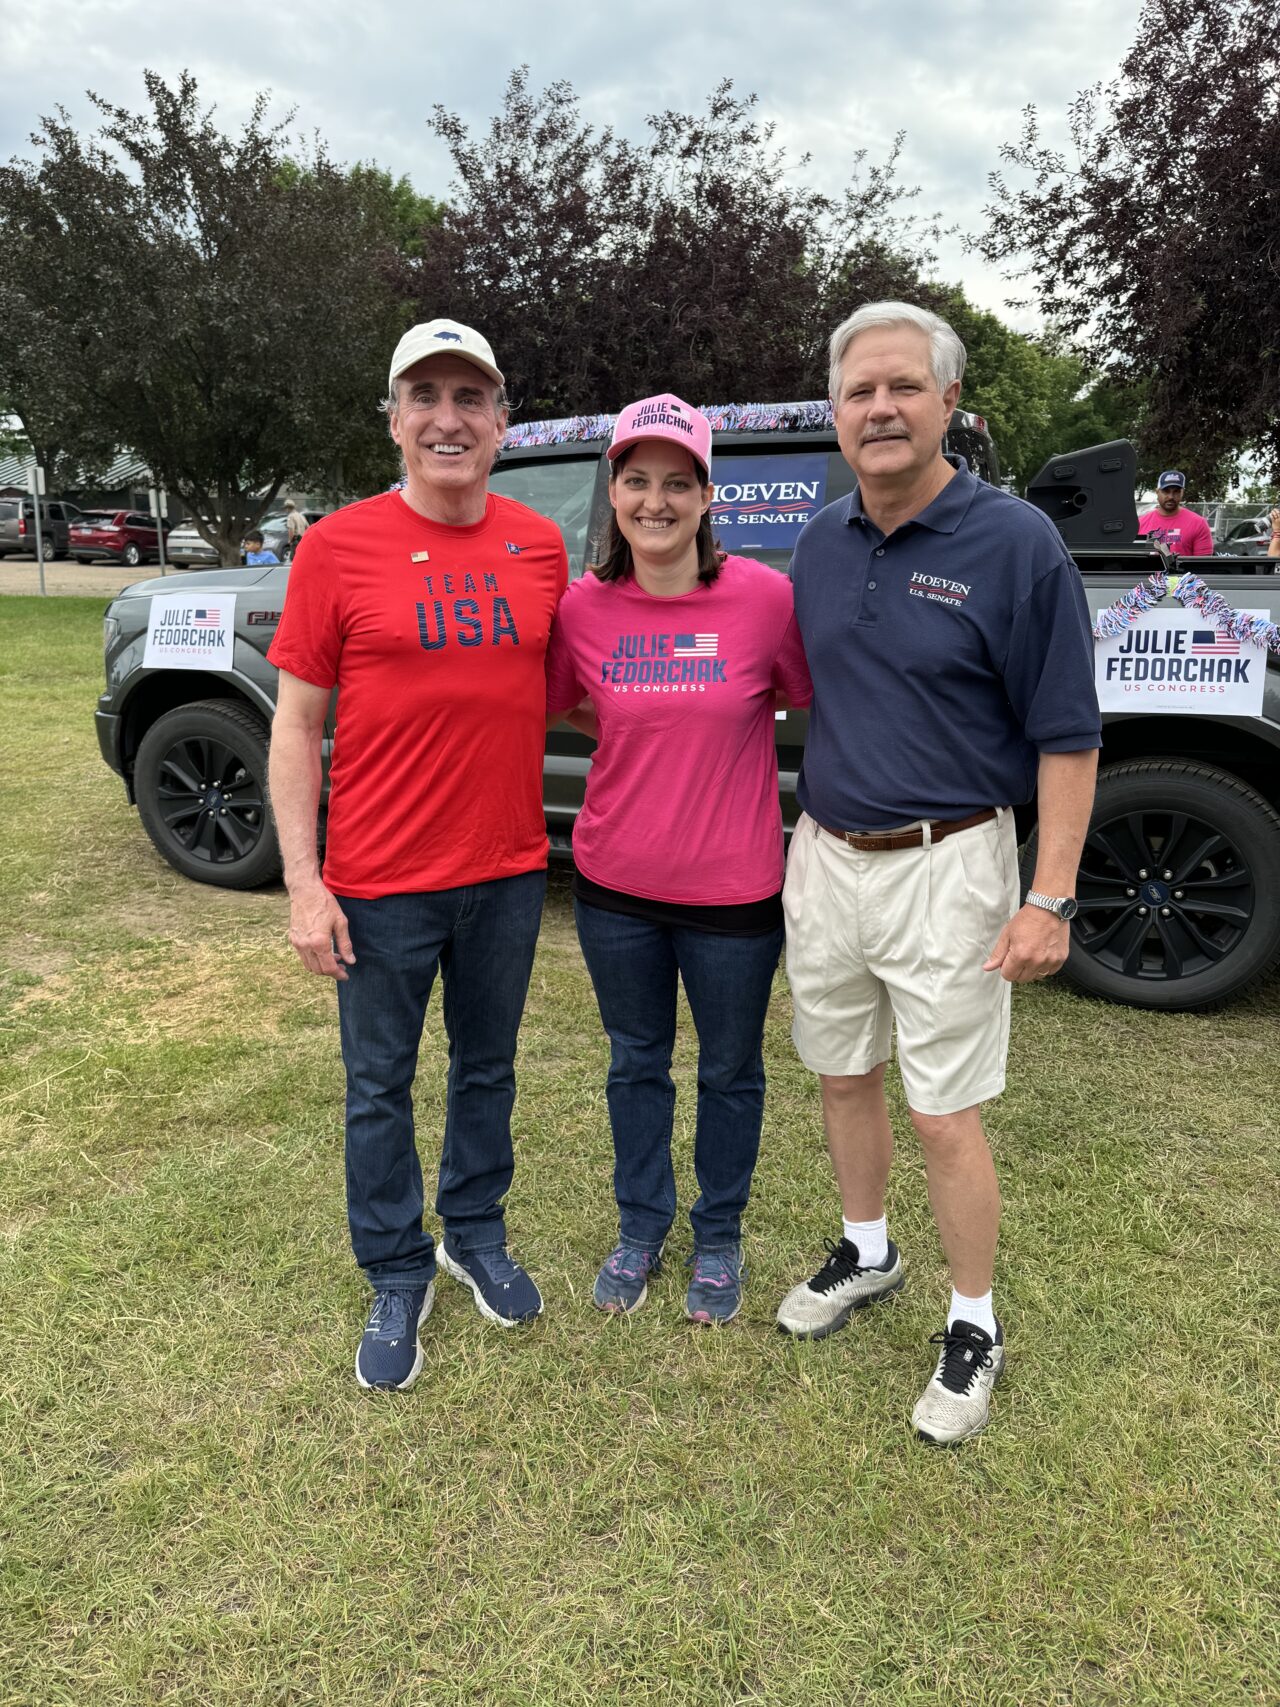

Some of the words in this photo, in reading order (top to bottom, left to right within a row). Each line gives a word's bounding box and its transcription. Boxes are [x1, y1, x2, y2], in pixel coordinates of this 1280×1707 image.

[637, 402, 668, 417] JULIE
[631, 413, 694, 436] FEDORCHAK
[737, 513, 808, 525] SENATE
[423, 572, 499, 596] TEAM
[910, 571, 972, 596] HOEVEN
[909, 588, 925, 598] U.S.
[926, 592, 963, 607] SENATE
[160, 609, 193, 626] JULIE
[416, 595, 519, 651] USA
[152, 628, 226, 648] FEDORCHAK
[612, 634, 671, 659] JULIE
[1119, 630, 1188, 655] JULIE
[170, 647, 213, 655] CONGRESS
[601, 659, 728, 684] FEDORCHAK
[1106, 657, 1251, 684] FEDORCHAK
[613, 685, 628, 693] US
[633, 684, 706, 693] CONGRESS
[1124, 684, 1141, 692] US
[1147, 684, 1226, 693] CONGRESS
